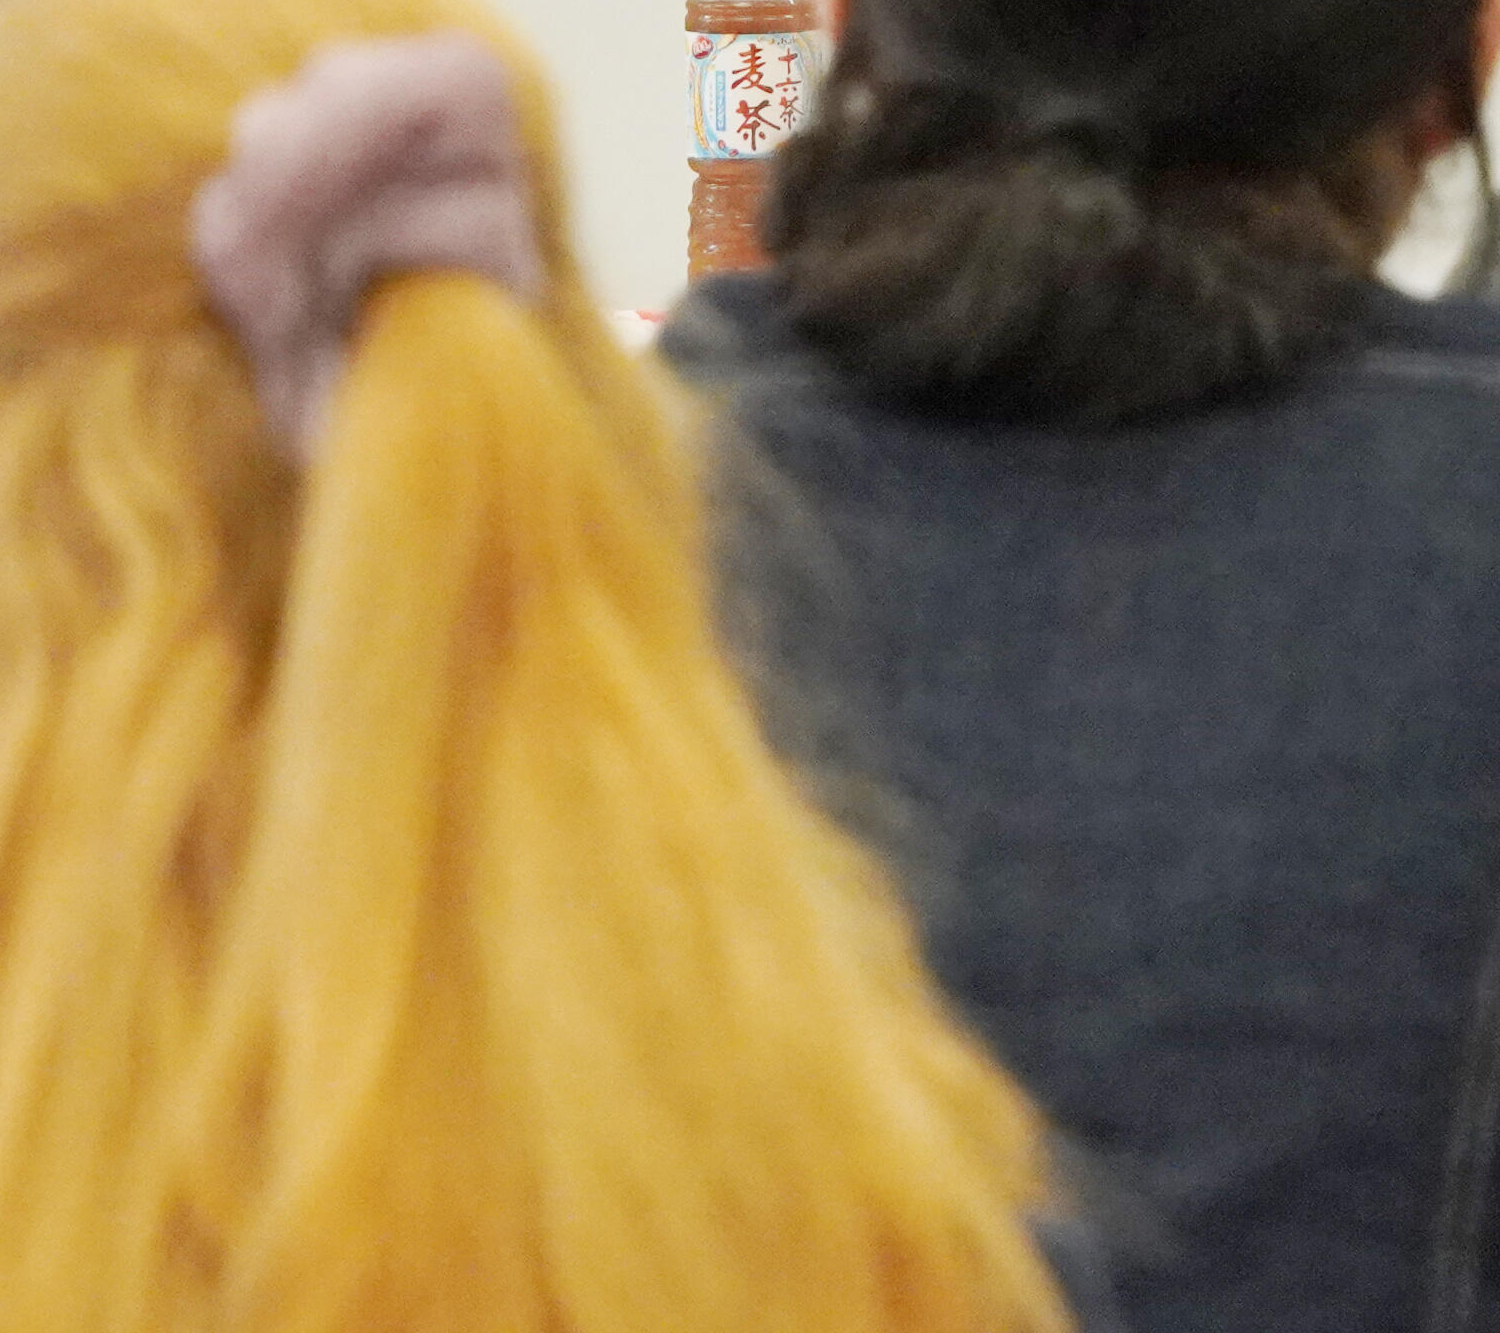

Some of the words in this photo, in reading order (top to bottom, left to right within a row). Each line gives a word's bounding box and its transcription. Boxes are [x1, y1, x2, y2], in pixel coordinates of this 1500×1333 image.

[731, 43, 781, 151] 麦茶
[775, 47, 805, 131] 十六茶
